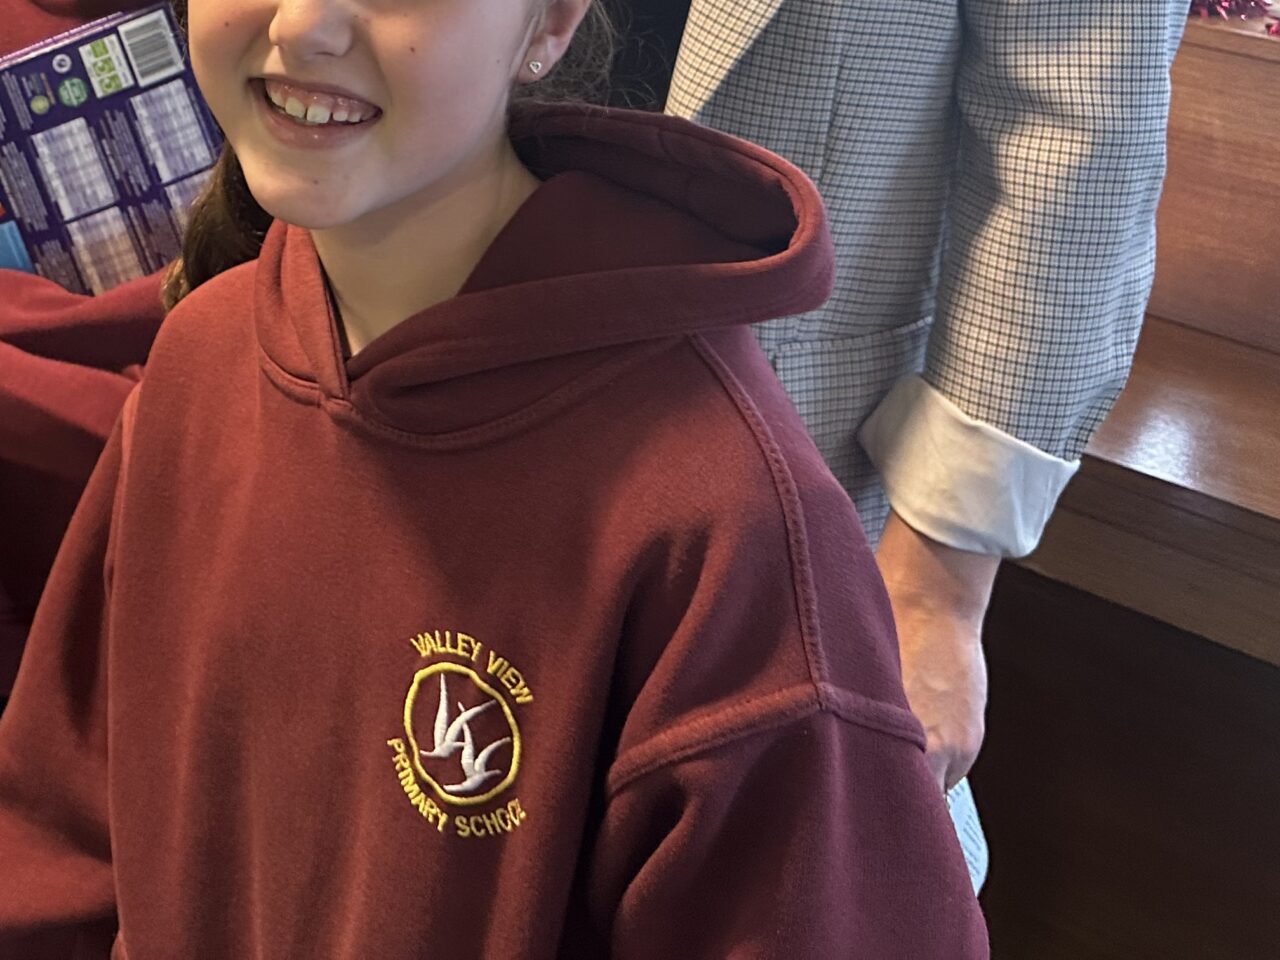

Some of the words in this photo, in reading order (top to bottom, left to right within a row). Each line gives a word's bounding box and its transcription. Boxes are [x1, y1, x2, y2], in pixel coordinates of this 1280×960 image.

[410, 630, 483, 661] VALLEY
[487, 650, 534, 704] VIEW
[387, 738, 449, 832] PRIMARY
[454, 798, 527, 838] SCHOOL
